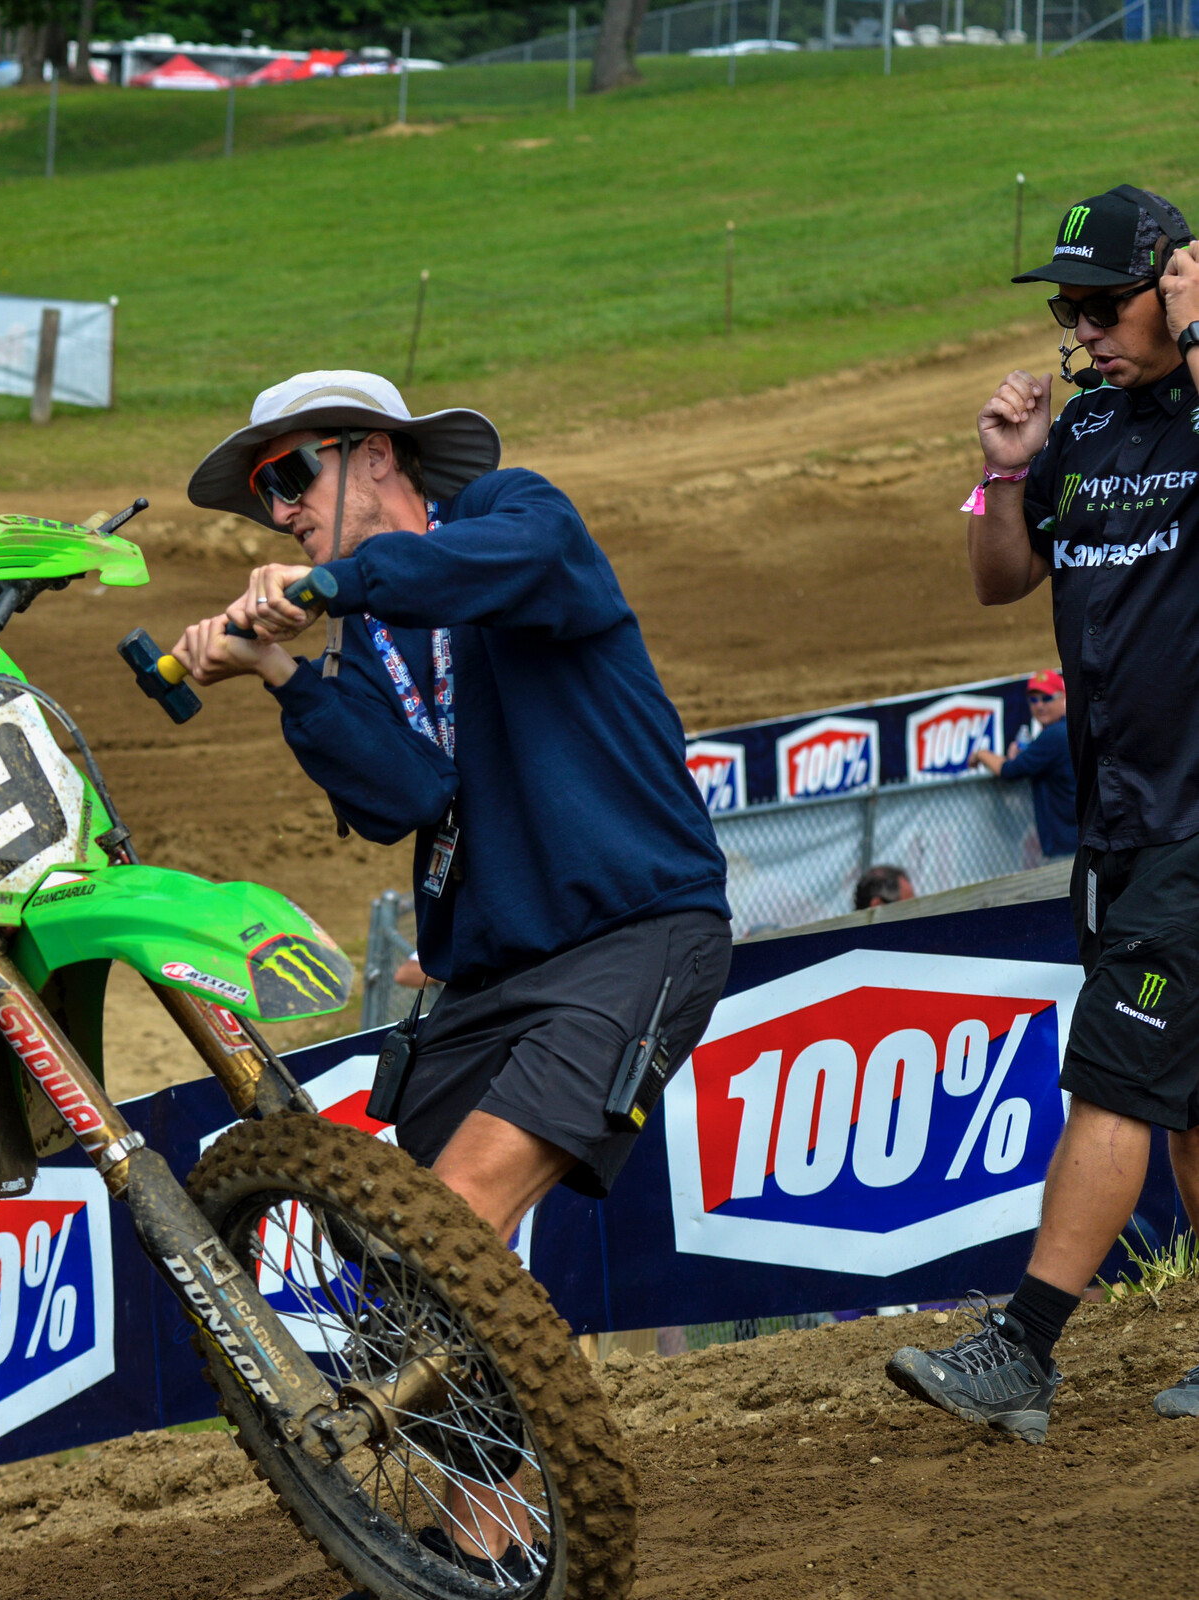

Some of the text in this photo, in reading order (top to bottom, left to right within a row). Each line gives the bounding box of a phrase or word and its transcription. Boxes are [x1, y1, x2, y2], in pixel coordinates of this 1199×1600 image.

[793, 735, 868, 797] 100%
[1115, 1001, 1167, 1030] Kawasaki
[727, 1012, 1032, 1199] 100%
[162, 1254, 280, 1405] DUNLOP
